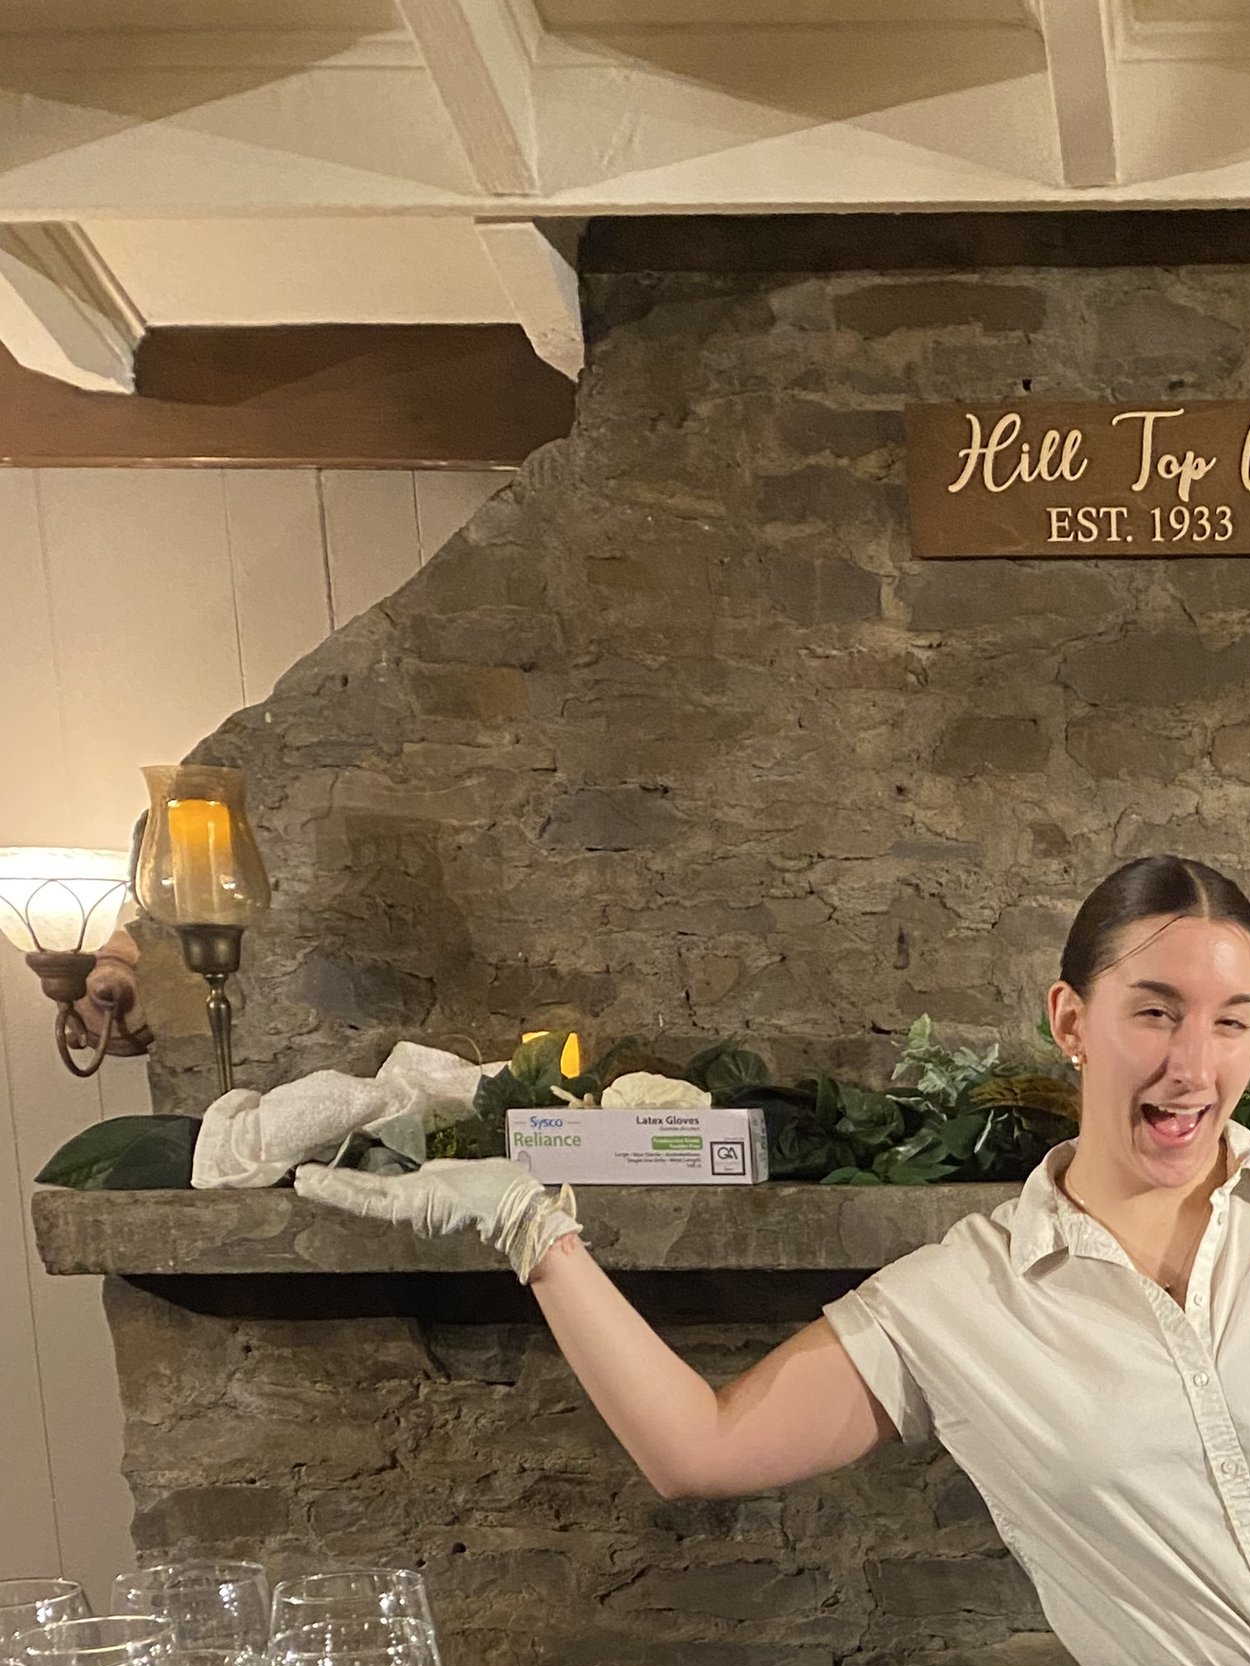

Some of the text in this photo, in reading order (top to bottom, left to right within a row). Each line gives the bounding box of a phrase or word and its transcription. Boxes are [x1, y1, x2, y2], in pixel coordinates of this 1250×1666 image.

[947, 412, 1088, 493] Hill
[1111, 408, 1216, 502] Top
[1045, 505, 1234, 543] EST. 1933
[529, 1115, 563, 1130] Sysco
[636, 1115, 699, 1126] Latex Gloves
[513, 1131, 582, 1148] Reliance
